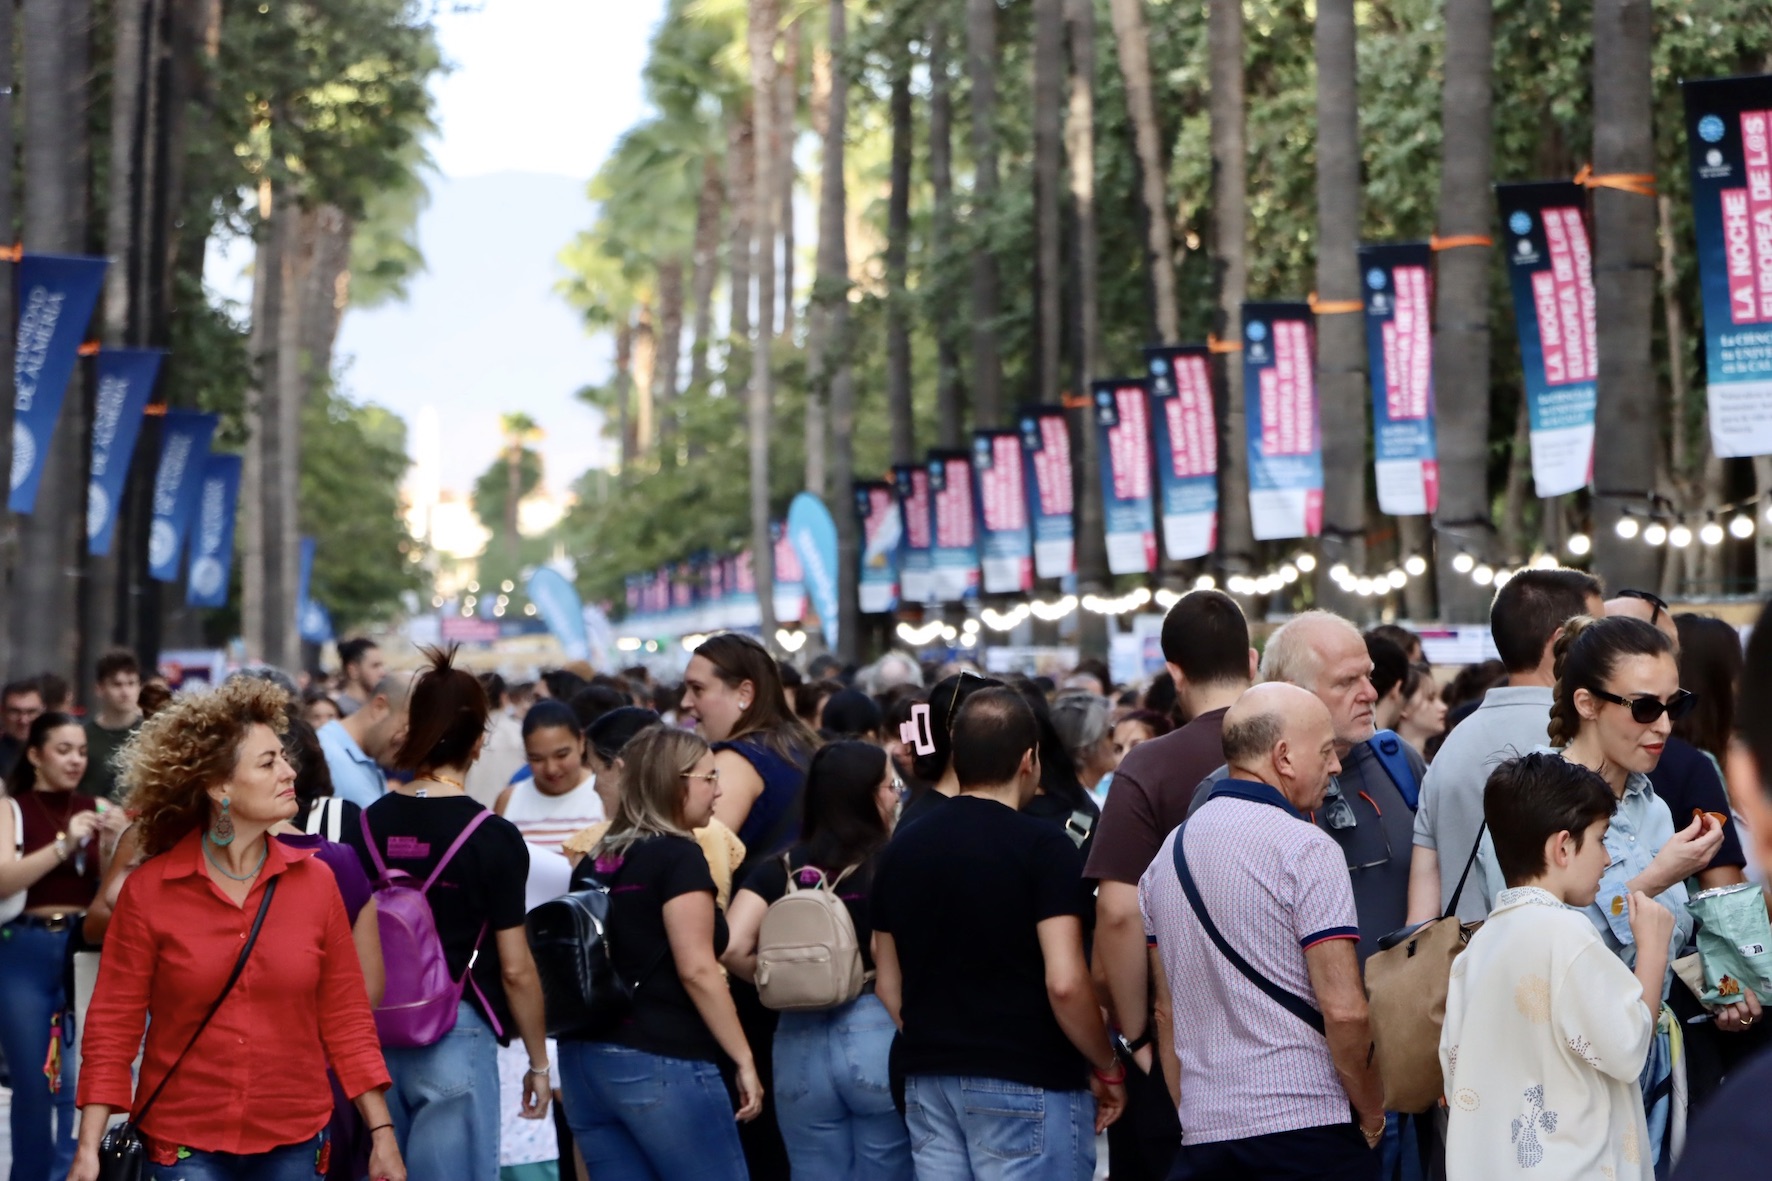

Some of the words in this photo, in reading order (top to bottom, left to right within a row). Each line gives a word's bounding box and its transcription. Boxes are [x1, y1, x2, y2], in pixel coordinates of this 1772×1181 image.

[1744, 115, 1769, 166] L@S
[1750, 170, 1772, 201] DE
[1725, 193, 1752, 277] NOCHE
[1553, 253, 1574, 282] DE
[1533, 275, 1561, 346] NOCHE
[1734, 286, 1755, 319] LA
[1559, 285, 1585, 379] EUROPEA
[1546, 351, 1565, 381] LA
